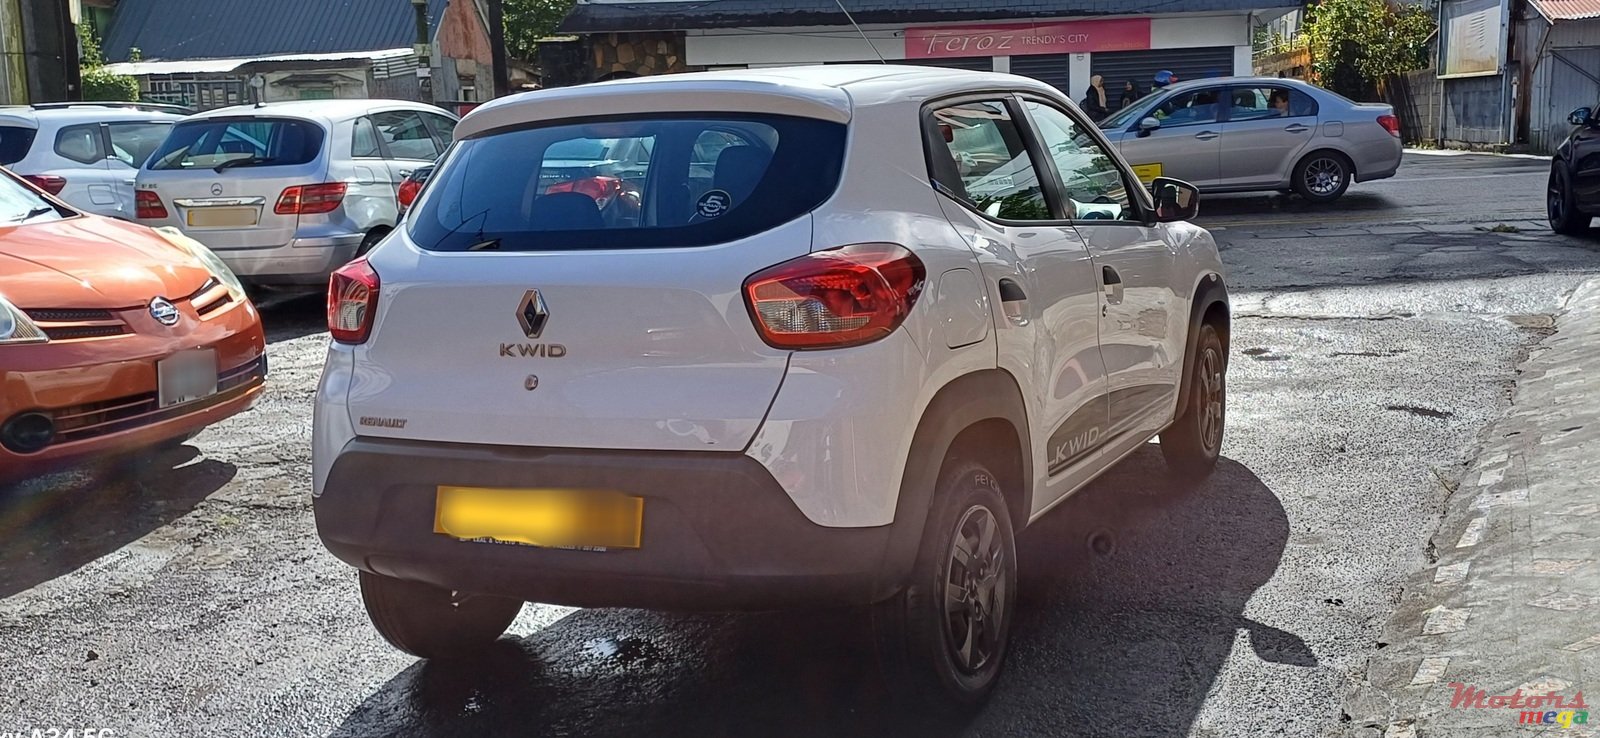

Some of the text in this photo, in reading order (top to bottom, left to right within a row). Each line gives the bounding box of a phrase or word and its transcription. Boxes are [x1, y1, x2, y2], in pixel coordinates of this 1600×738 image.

[1021, 34, 1066, 45] TRENDY'S
[1068, 33, 1089, 44] CITY
[499, 342, 567, 358] KWID
[359, 416, 408, 429] RENAULT
[1055, 426, 1099, 464] KWID
